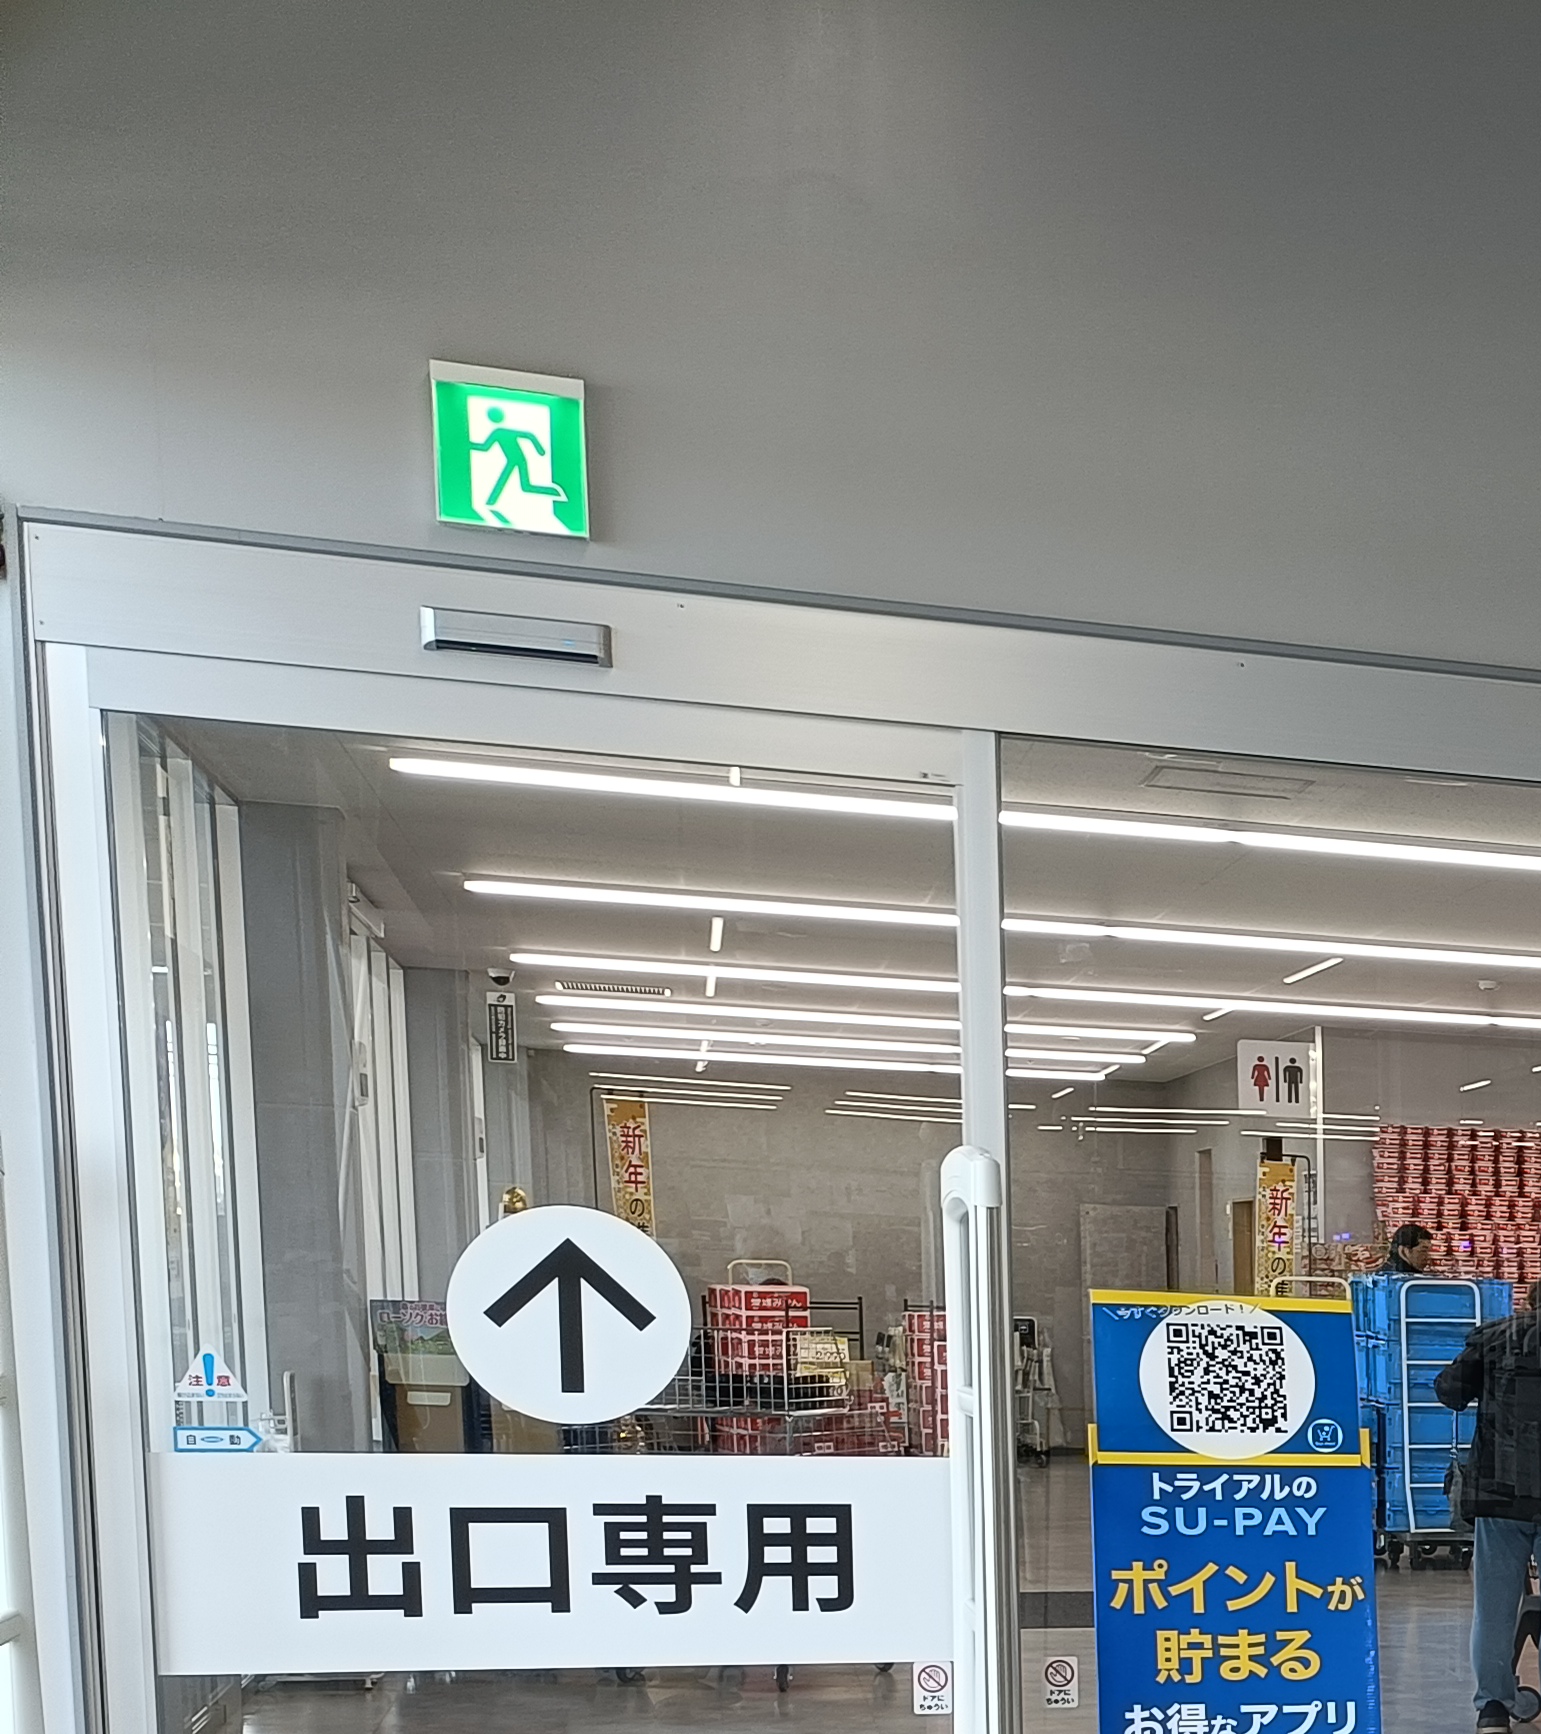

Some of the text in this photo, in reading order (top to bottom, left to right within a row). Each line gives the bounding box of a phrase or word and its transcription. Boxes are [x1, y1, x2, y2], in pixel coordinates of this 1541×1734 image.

[619, 1122, 651, 1237] 新年の
[187, 1435, 241, 1445] 自動
[1151, 1472, 1317, 1501] トライアルの
[1139, 1506, 1328, 1536] SU-PAY
[296, 1494, 857, 1620] 出口専用
[1109, 1559, 1365, 1614] ポイントが
[1155, 1628, 1321, 1684] 貯まる
[1046, 1697, 1074, 1705] ちゅうい
